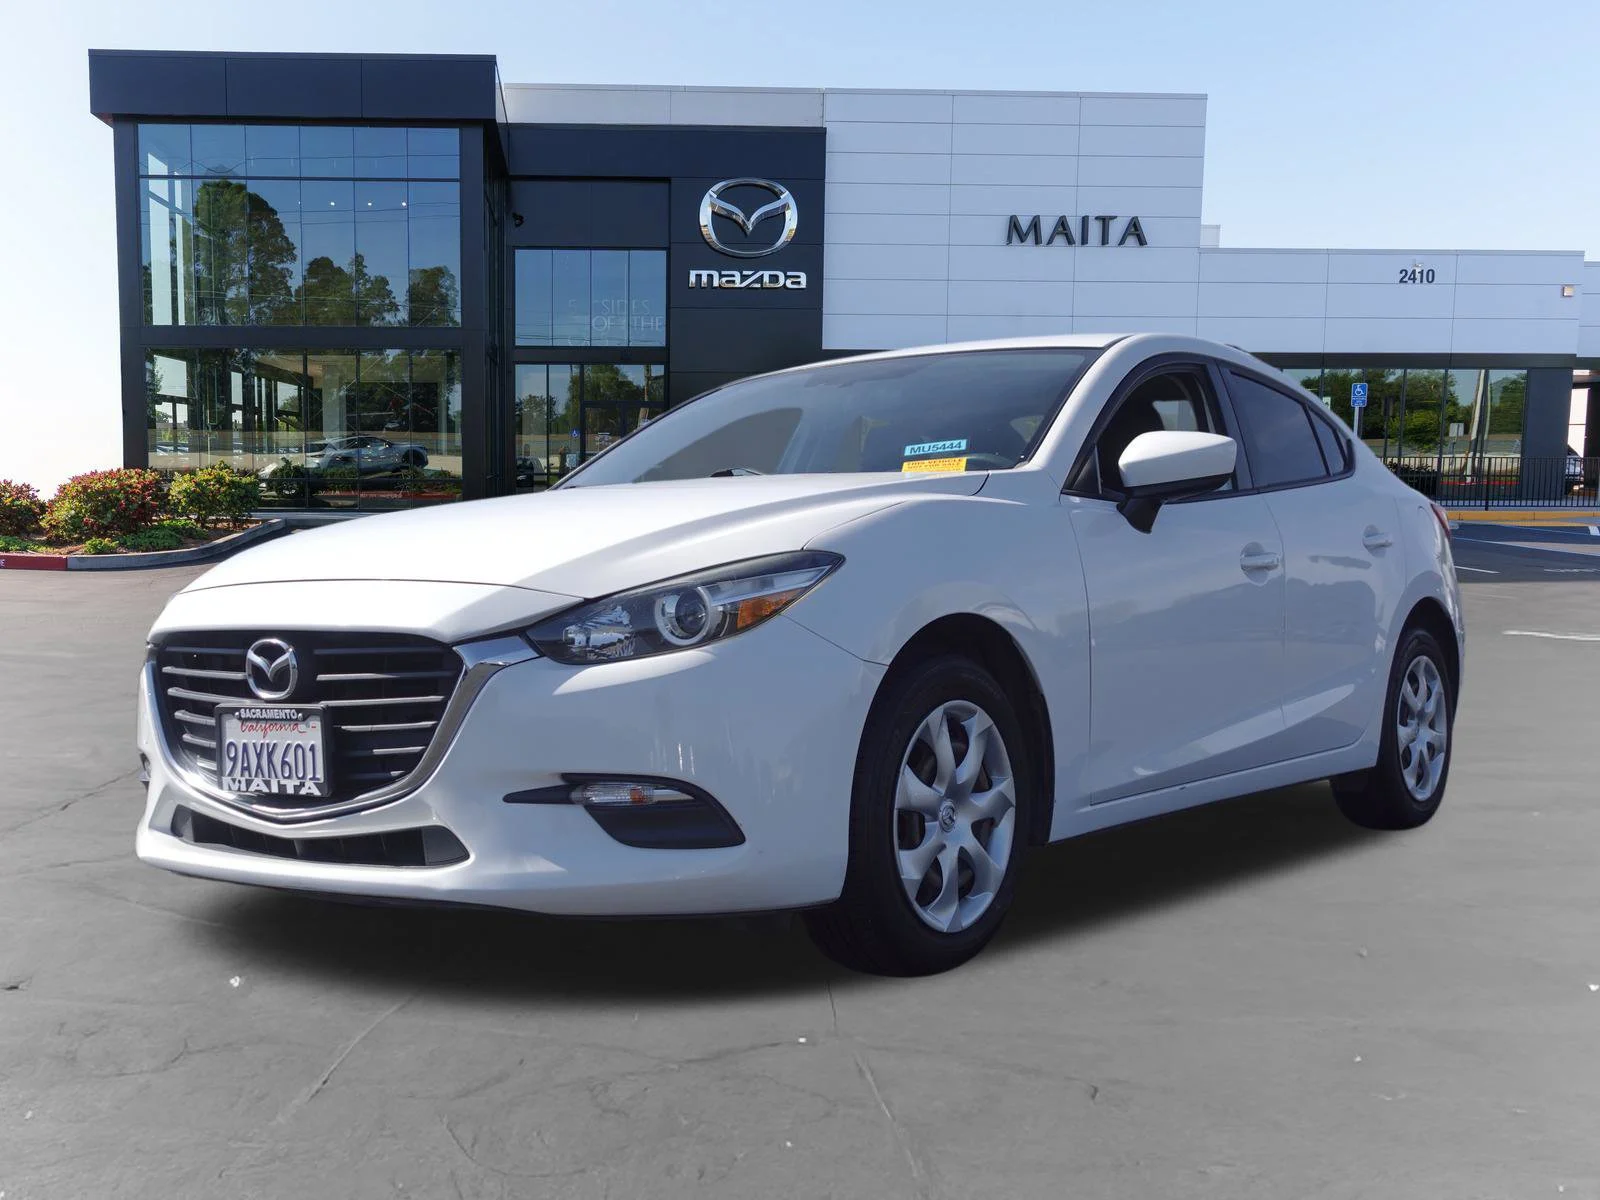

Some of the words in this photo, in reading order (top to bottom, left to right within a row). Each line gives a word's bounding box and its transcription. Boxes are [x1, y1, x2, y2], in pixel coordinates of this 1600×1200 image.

[1006, 214, 1148, 246] MAITA
[1398, 268, 1436, 284] 2410
[910, 442, 962, 454] MU5444
[240, 708, 298, 719] SACRAMENTO
[226, 741, 320, 780] 9AXK601
[222, 777, 321, 795] MAITA
